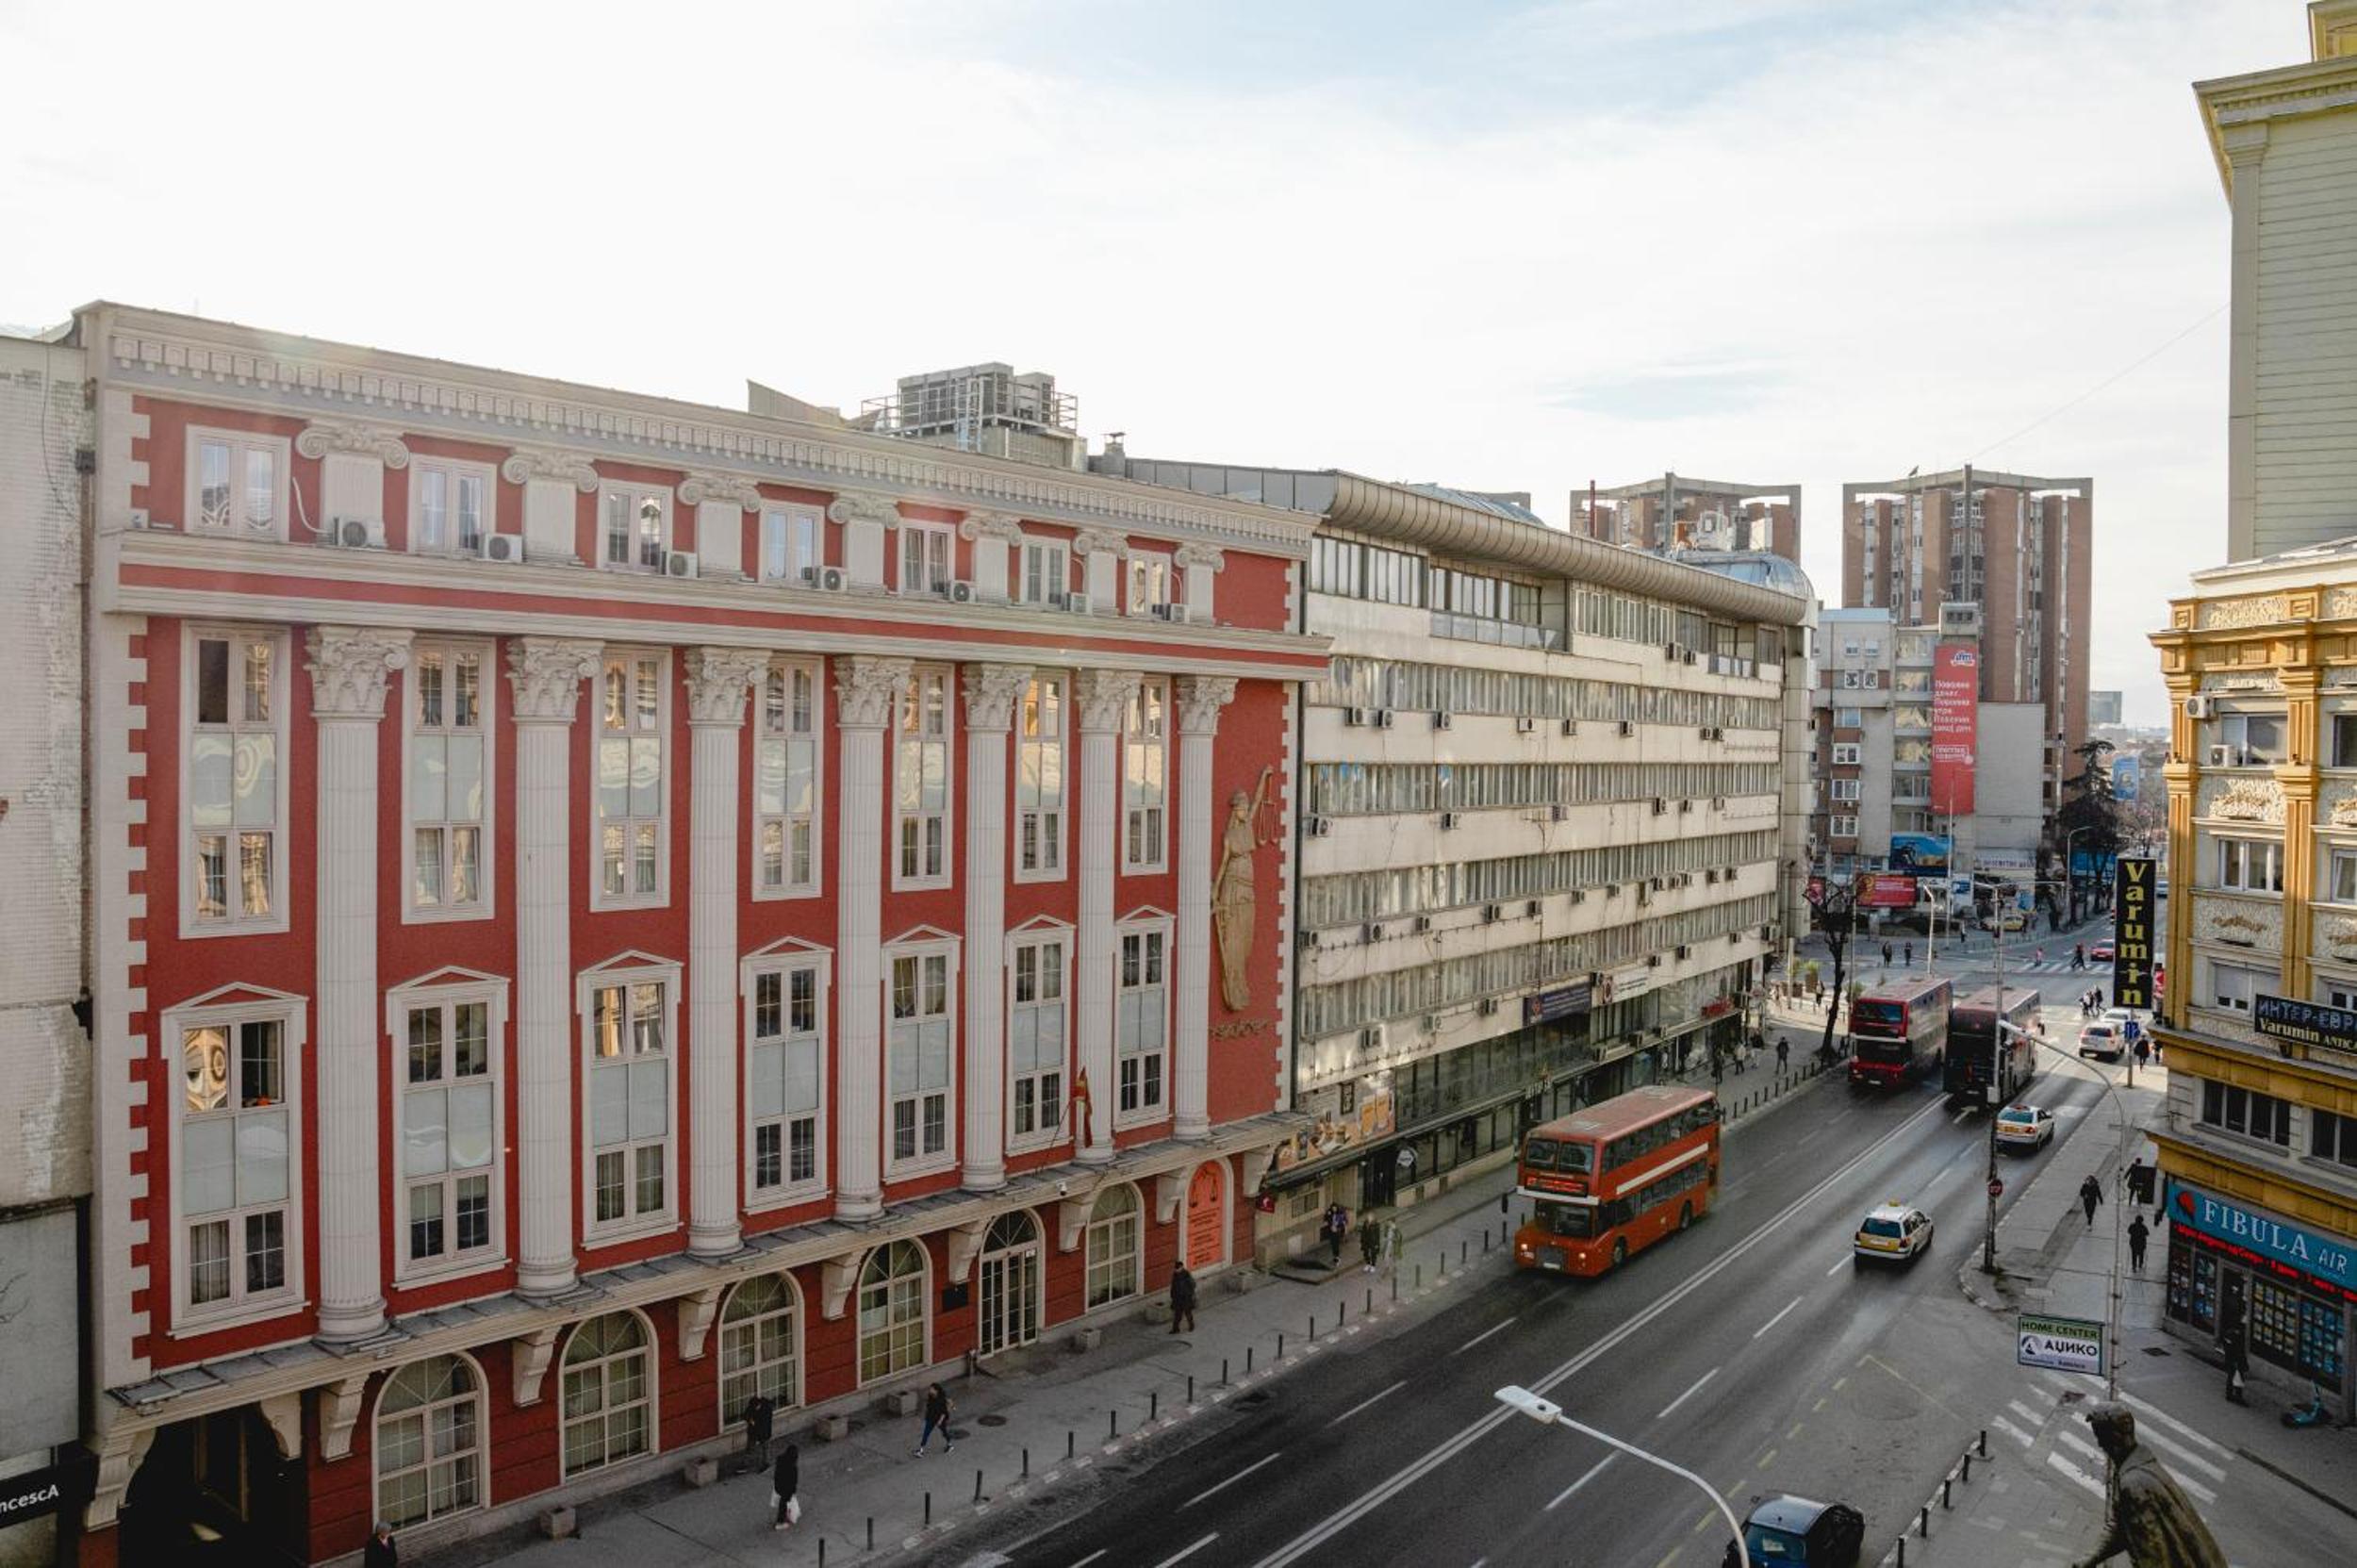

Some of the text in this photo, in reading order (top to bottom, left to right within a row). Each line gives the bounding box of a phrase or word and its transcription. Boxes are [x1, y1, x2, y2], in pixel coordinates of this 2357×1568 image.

[2120, 862, 2147, 1005] Varumin
[2258, 999, 2357, 1031] ИНТЕР-ЕВР
[2260, 1017, 2319, 1043] Varumin
[2203, 1199, 2310, 1261] FIBULA
[2318, 1248, 2348, 1276] AIR
[2021, 1321, 2098, 1339] HOME CENTER
[2044, 1340, 2098, 1357] АЏИКО
